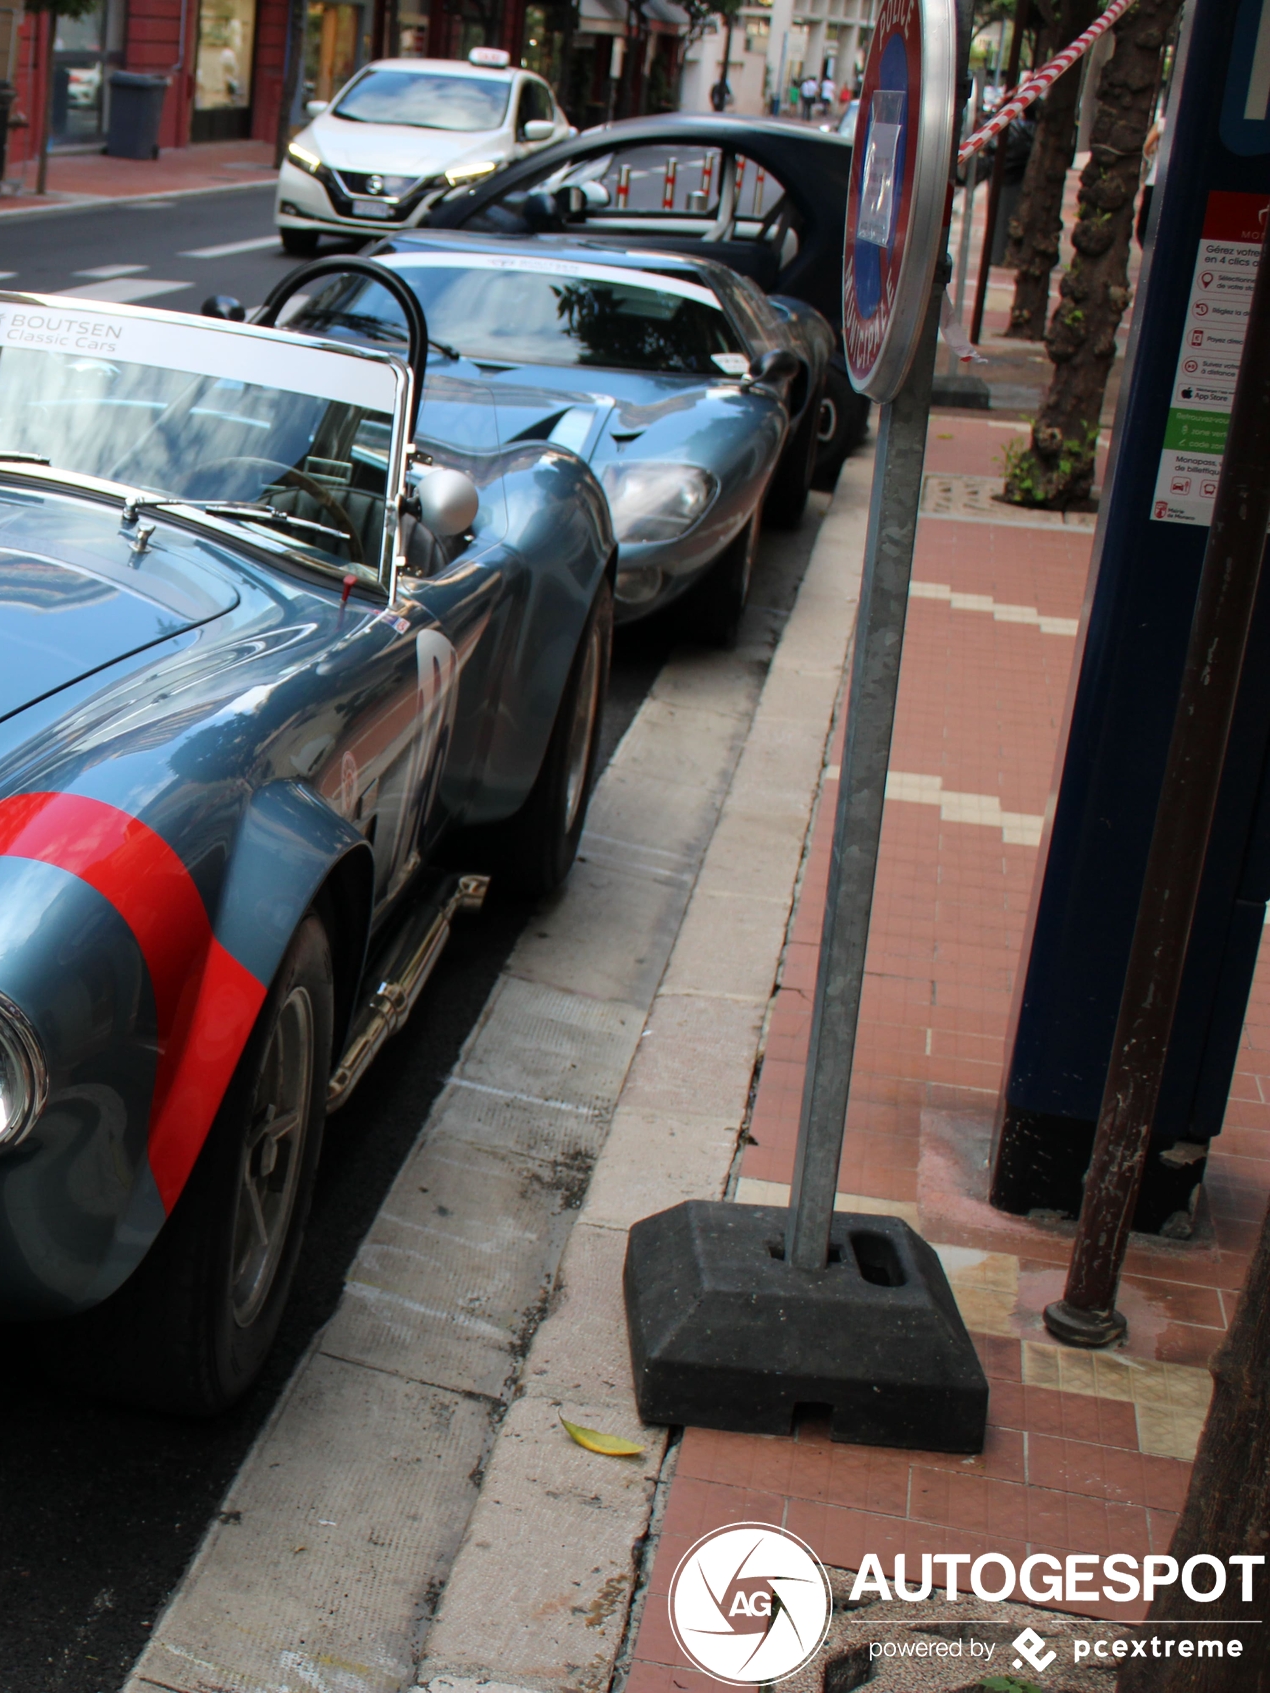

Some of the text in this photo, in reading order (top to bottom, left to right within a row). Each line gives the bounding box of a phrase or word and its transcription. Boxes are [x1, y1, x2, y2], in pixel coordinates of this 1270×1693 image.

[879, 0, 915, 52] POLICE
[1204, 256, 1217, 264] en
[1219, 256, 1226, 264] 4
[1228, 257, 1250, 267] clics
[1206, 244, 1261, 257] Gérez votre
[845, 255, 895, 370] MUNICIPALE
[11, 313, 123, 339] BOUTSEN
[7, 328, 117, 352] Classic Cars
[1194, 393, 1228, 402] App Store
